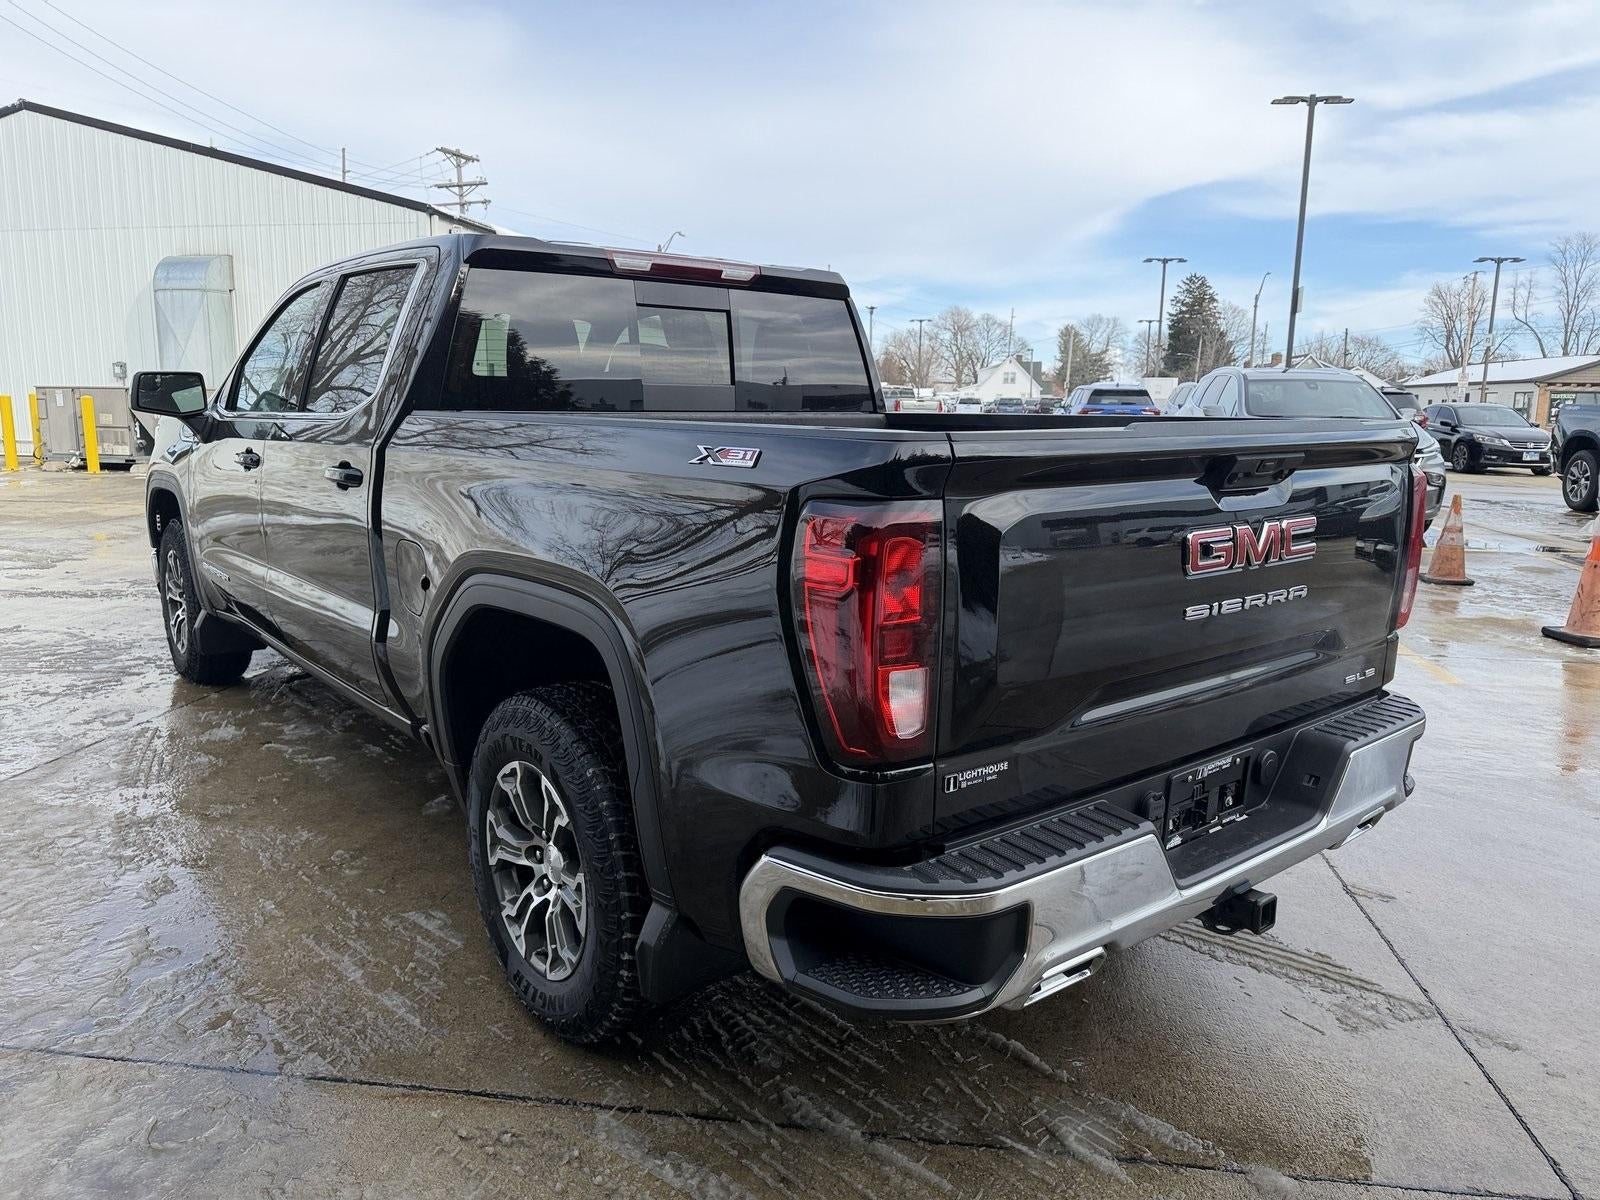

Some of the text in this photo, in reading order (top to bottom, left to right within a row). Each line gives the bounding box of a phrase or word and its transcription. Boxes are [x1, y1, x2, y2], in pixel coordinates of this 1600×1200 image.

[688, 445, 761, 468] X31
[1184, 515, 1318, 577] GMC
[1184, 584, 1308, 621] SIERRA
[959, 760, 1009, 781] LIGHTHOUSE
